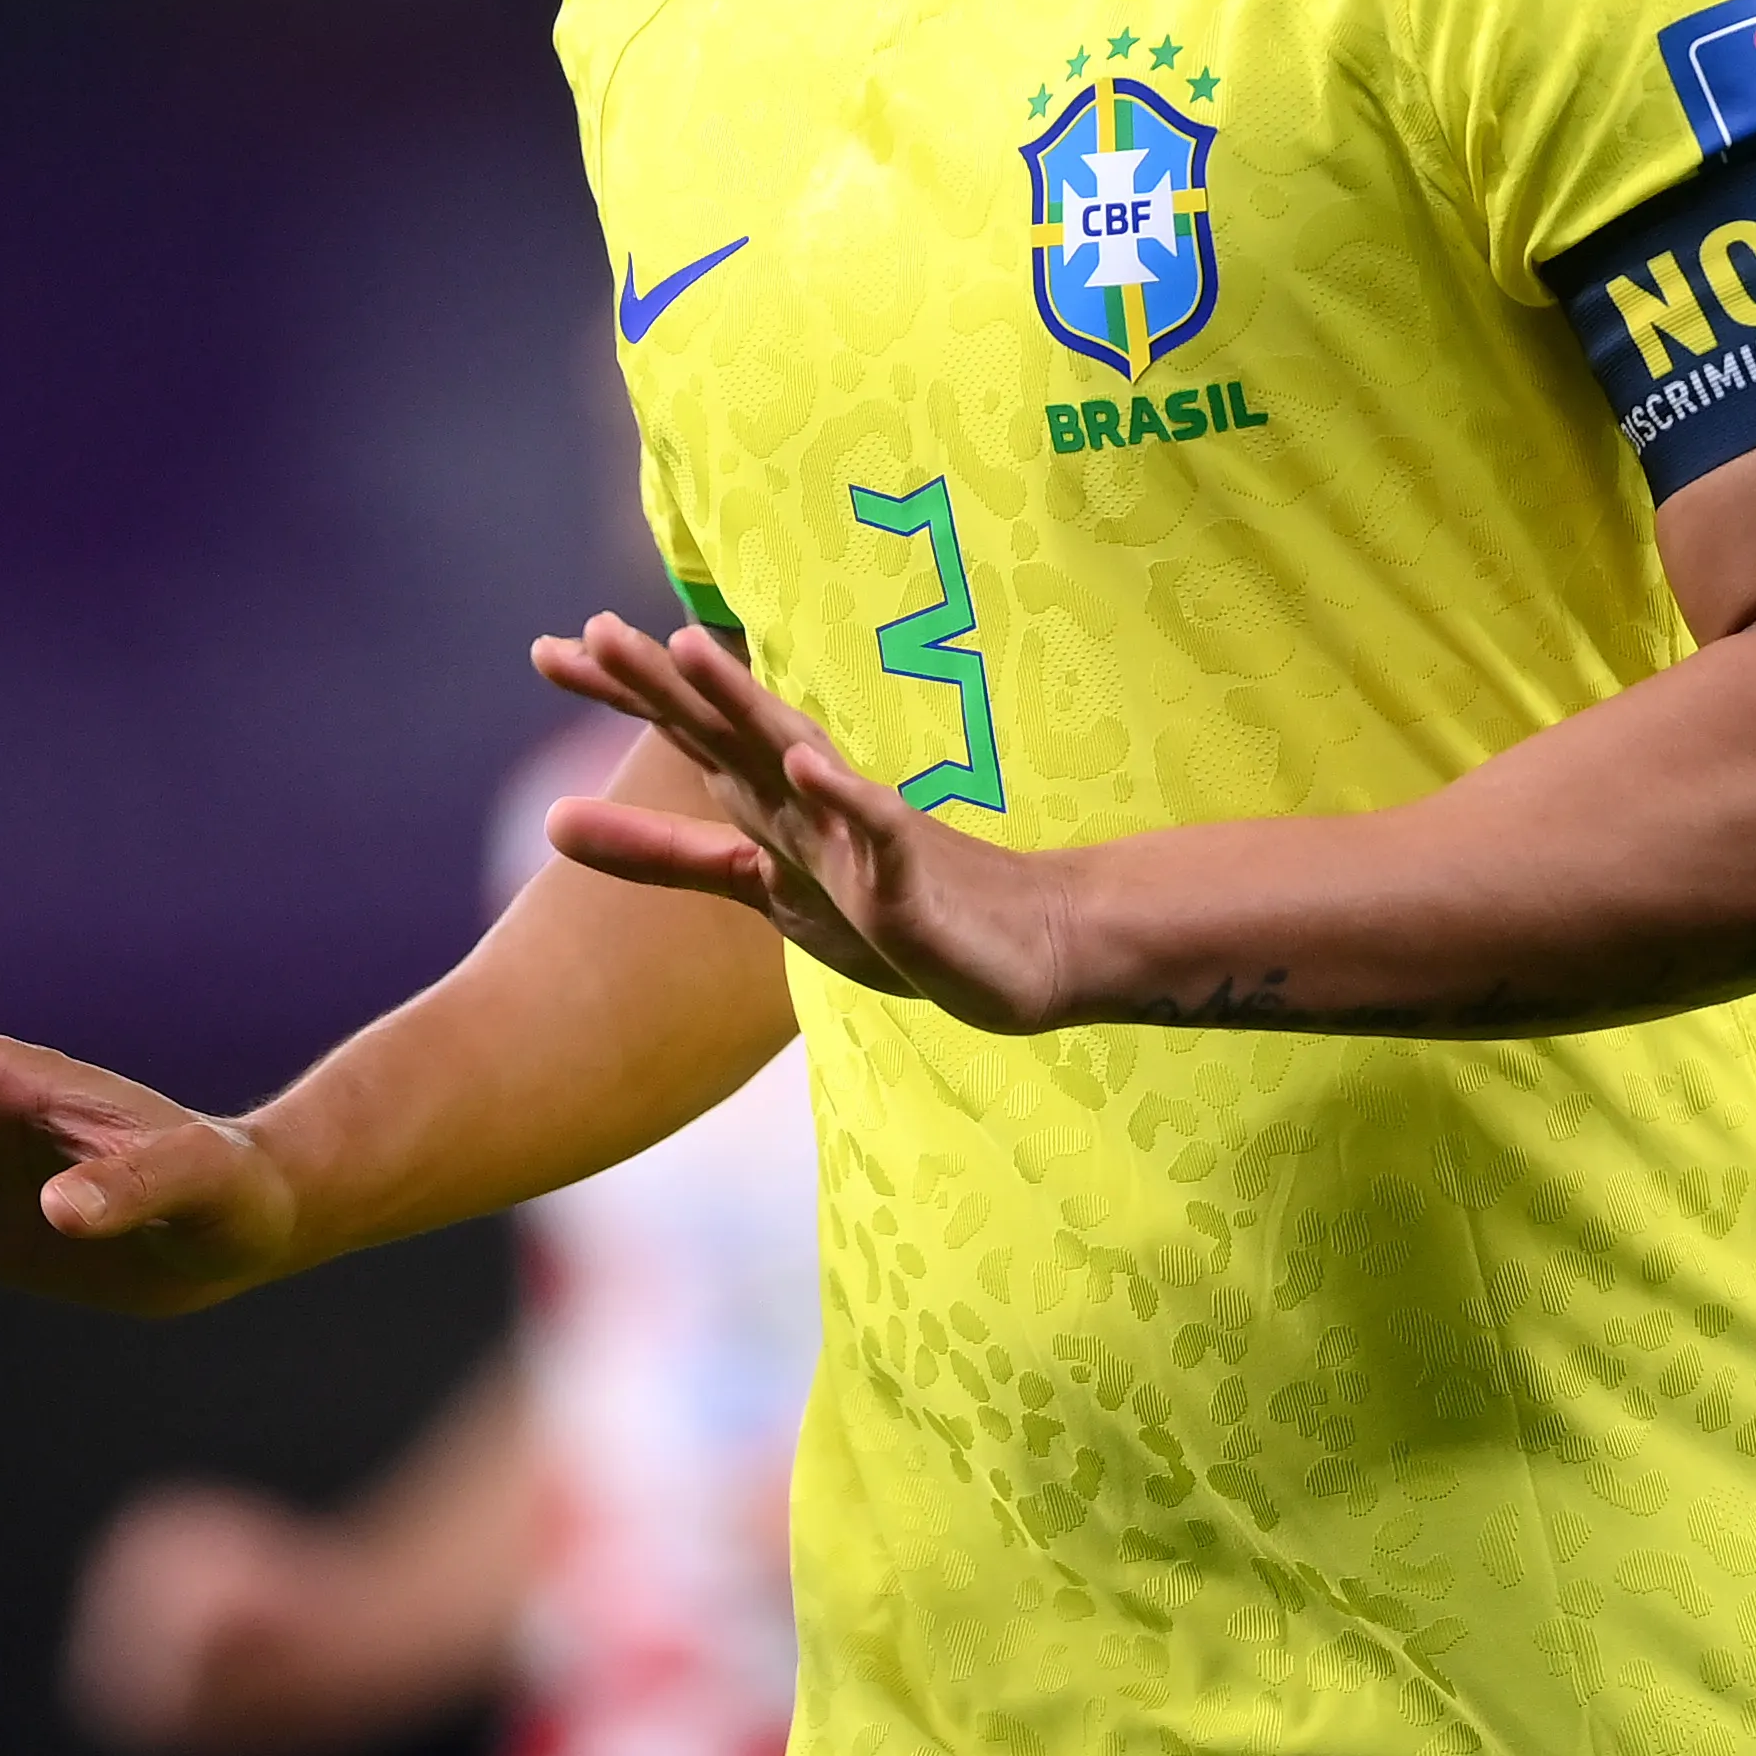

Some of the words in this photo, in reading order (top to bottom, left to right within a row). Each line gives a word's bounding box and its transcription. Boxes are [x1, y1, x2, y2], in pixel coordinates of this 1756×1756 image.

[1081, 199, 1152, 237] CBF
[1044, 380, 1270, 455] BRASIL
[847, 474, 1007, 814] 3
